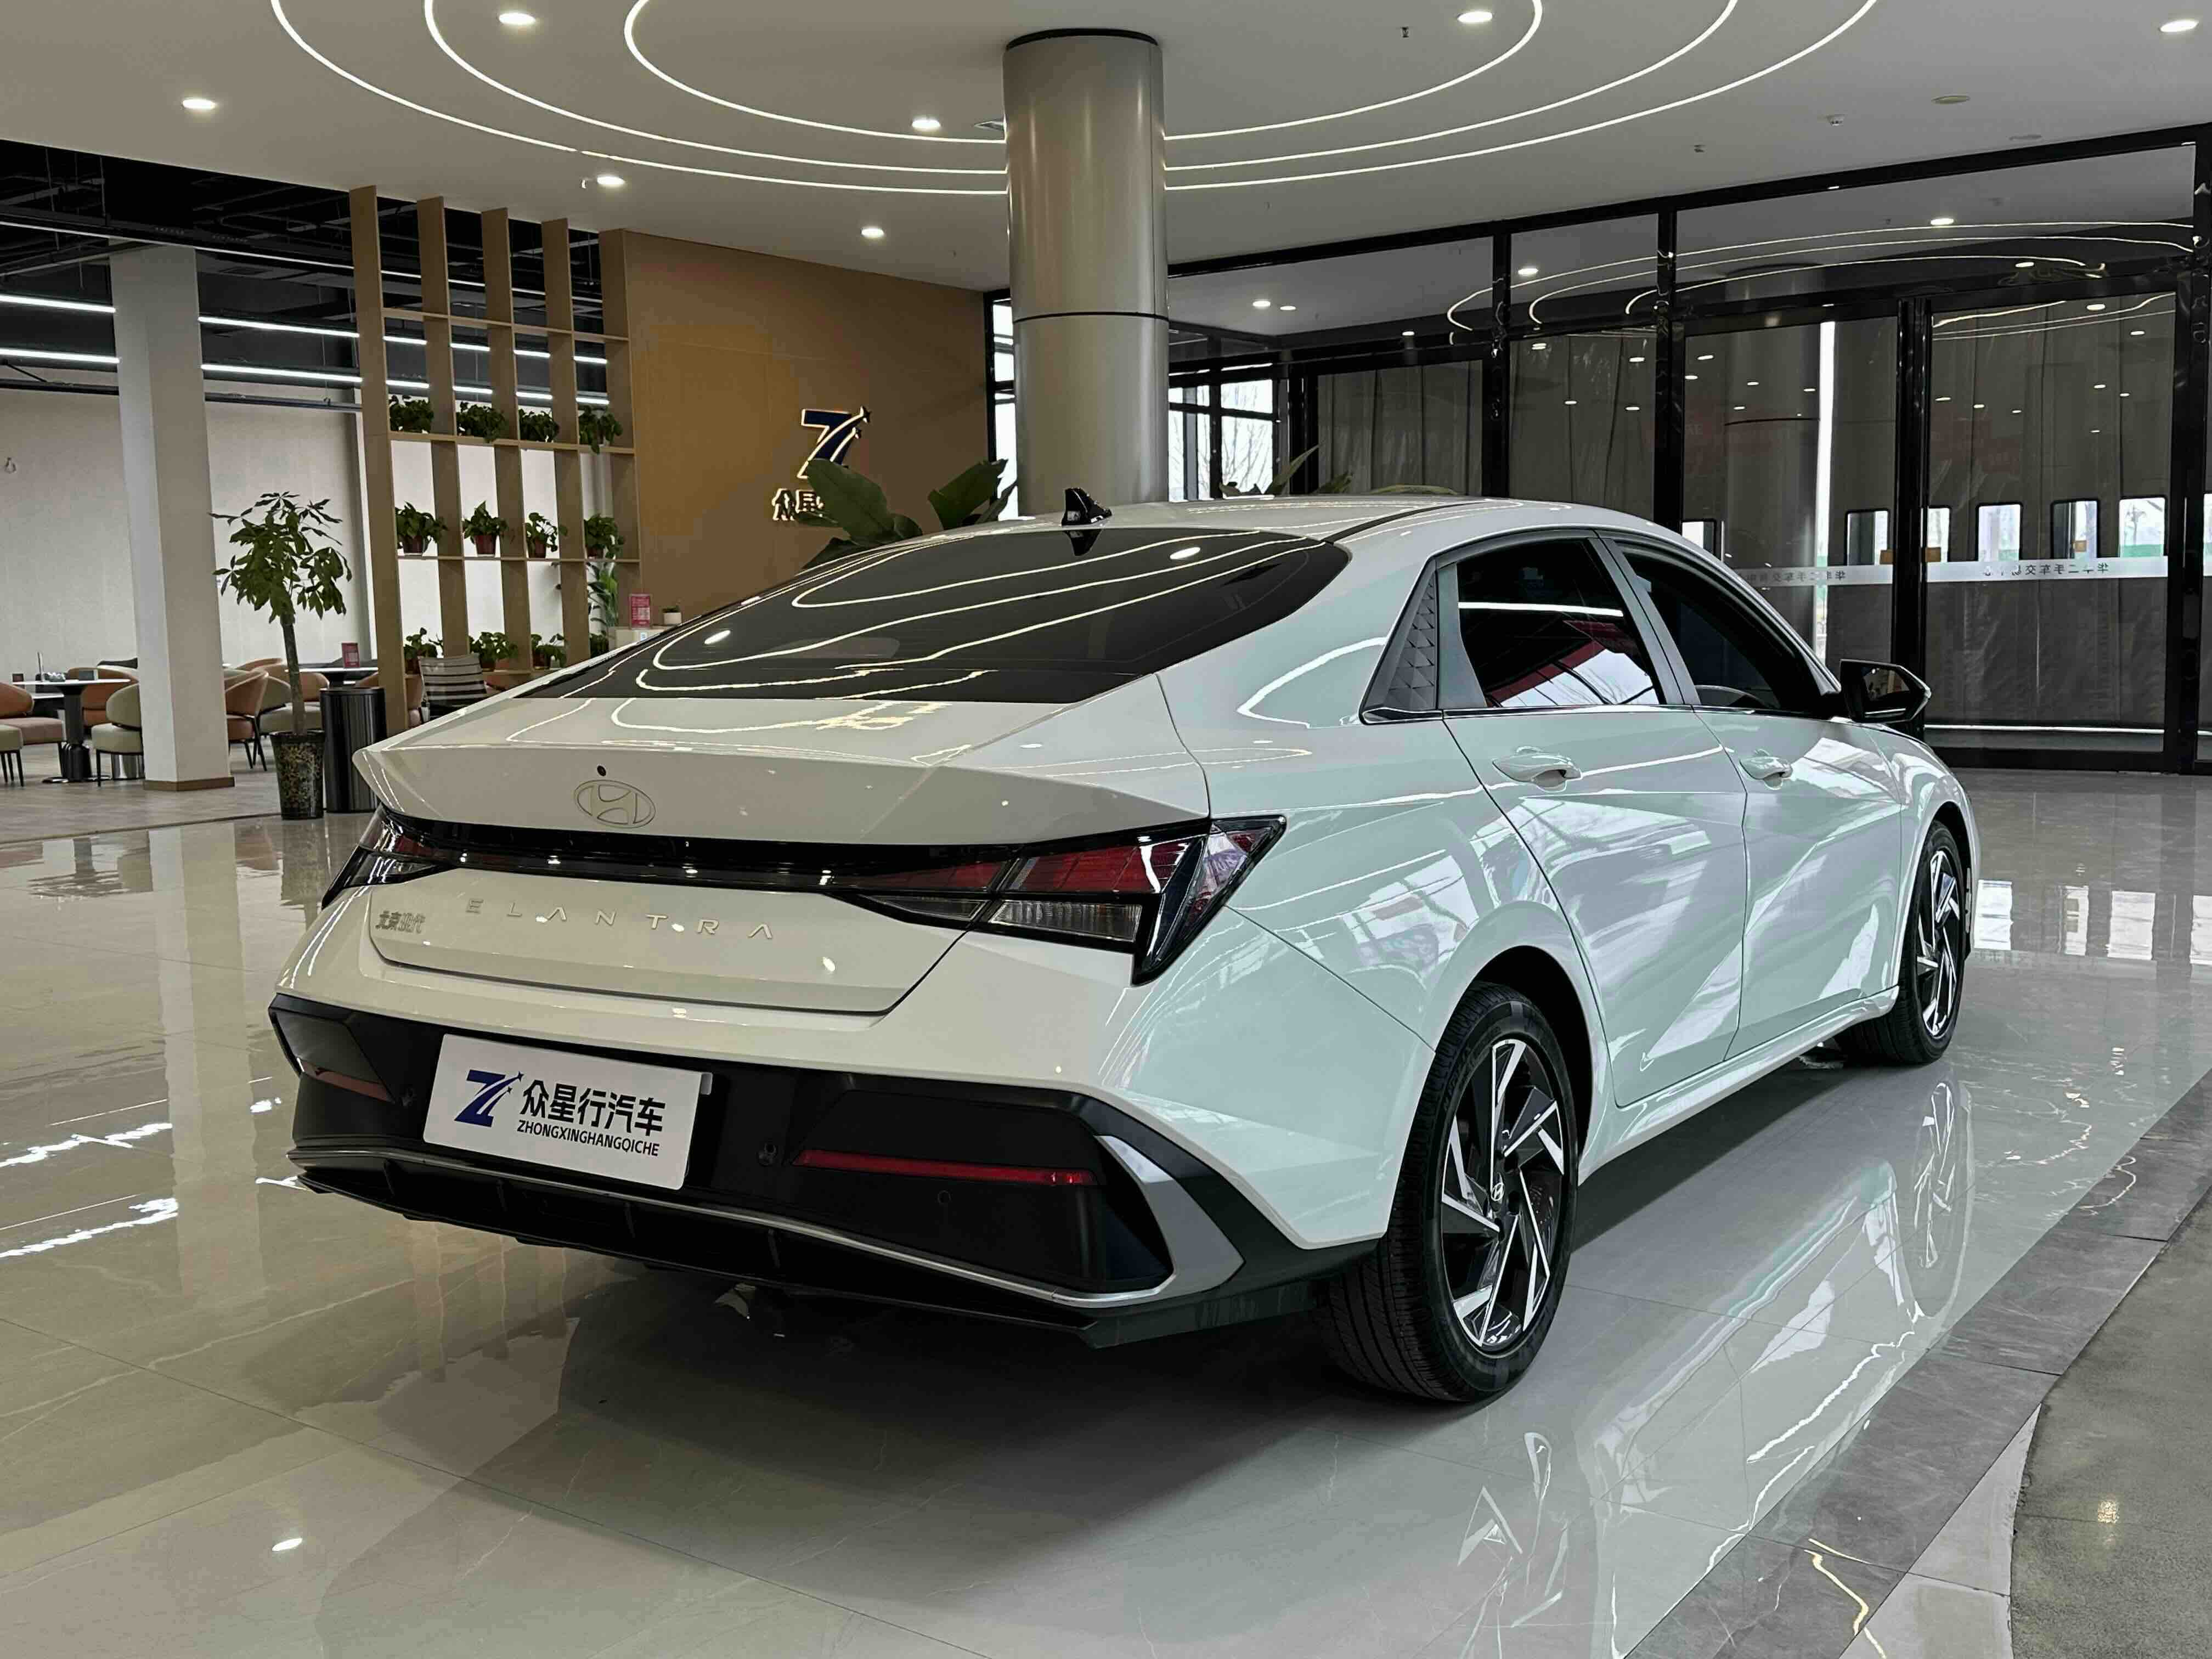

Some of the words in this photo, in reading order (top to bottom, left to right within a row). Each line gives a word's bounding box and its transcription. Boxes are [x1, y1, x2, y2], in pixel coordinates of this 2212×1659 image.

[465, 898, 773, 940] ELANTRA
[520, 1079, 665, 1137] 众星行汽车
[517, 1120, 660, 1156] ZHONGXINGHANGQICHE
